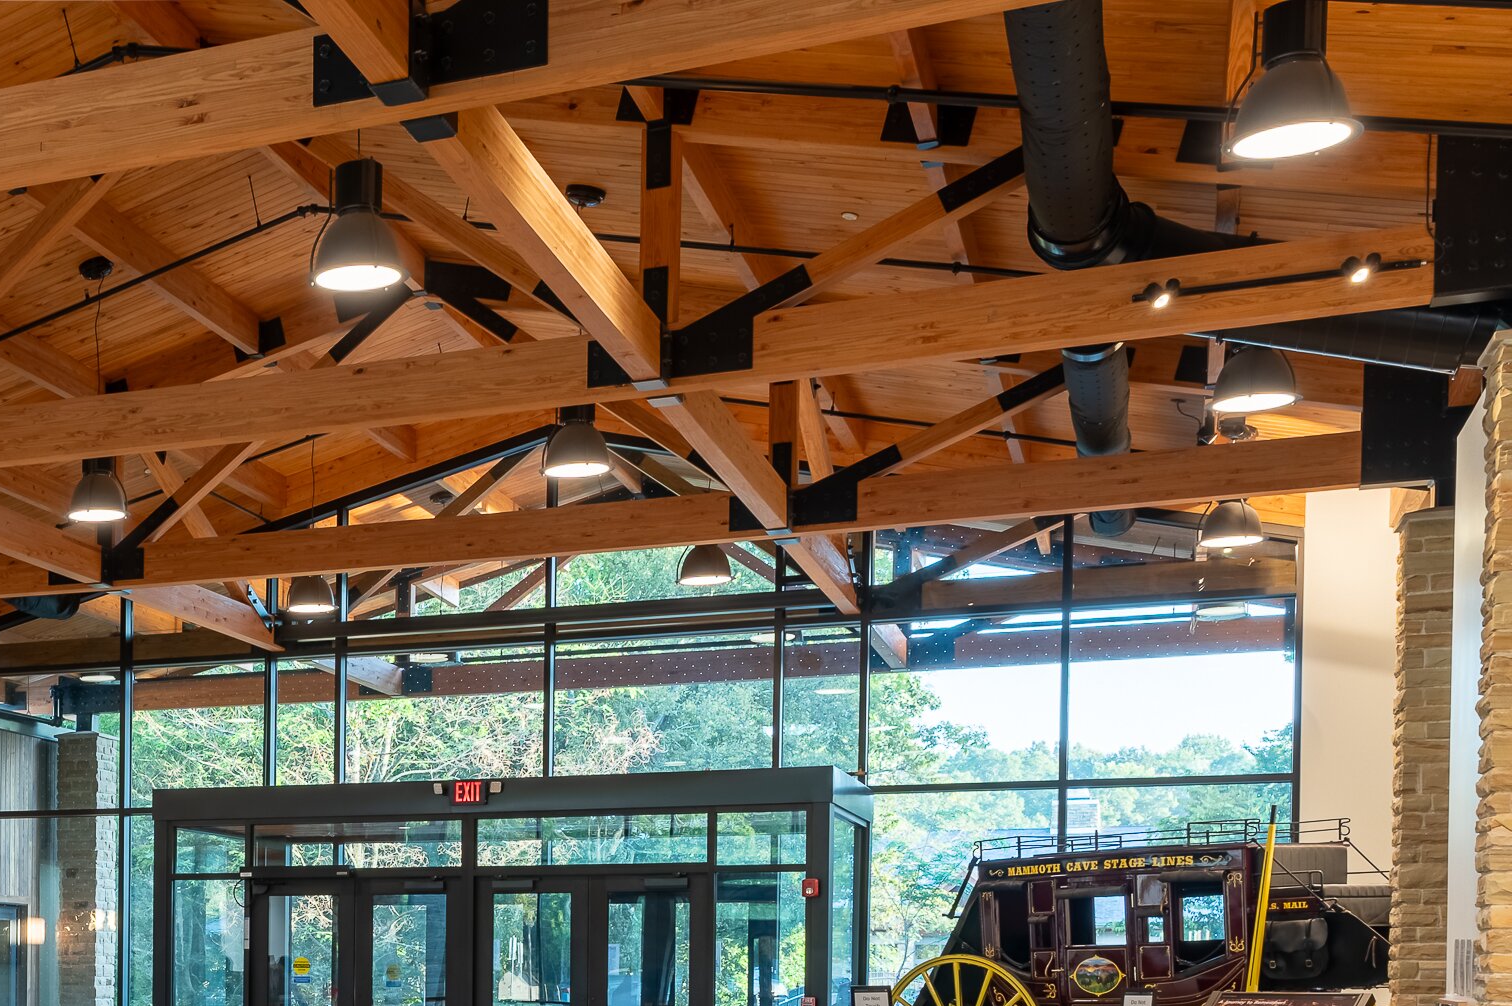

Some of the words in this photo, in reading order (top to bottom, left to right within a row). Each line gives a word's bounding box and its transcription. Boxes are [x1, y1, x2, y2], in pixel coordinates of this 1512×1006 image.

[455, 781, 481, 802] EXIT
[1007, 863, 1061, 877] MAMMOTH
[1066, 861, 1098, 872] CAVE
[1103, 857, 1146, 870] STAGE
[1151, 855, 1194, 867] LINES
[1283, 901, 1308, 909] MAIL
